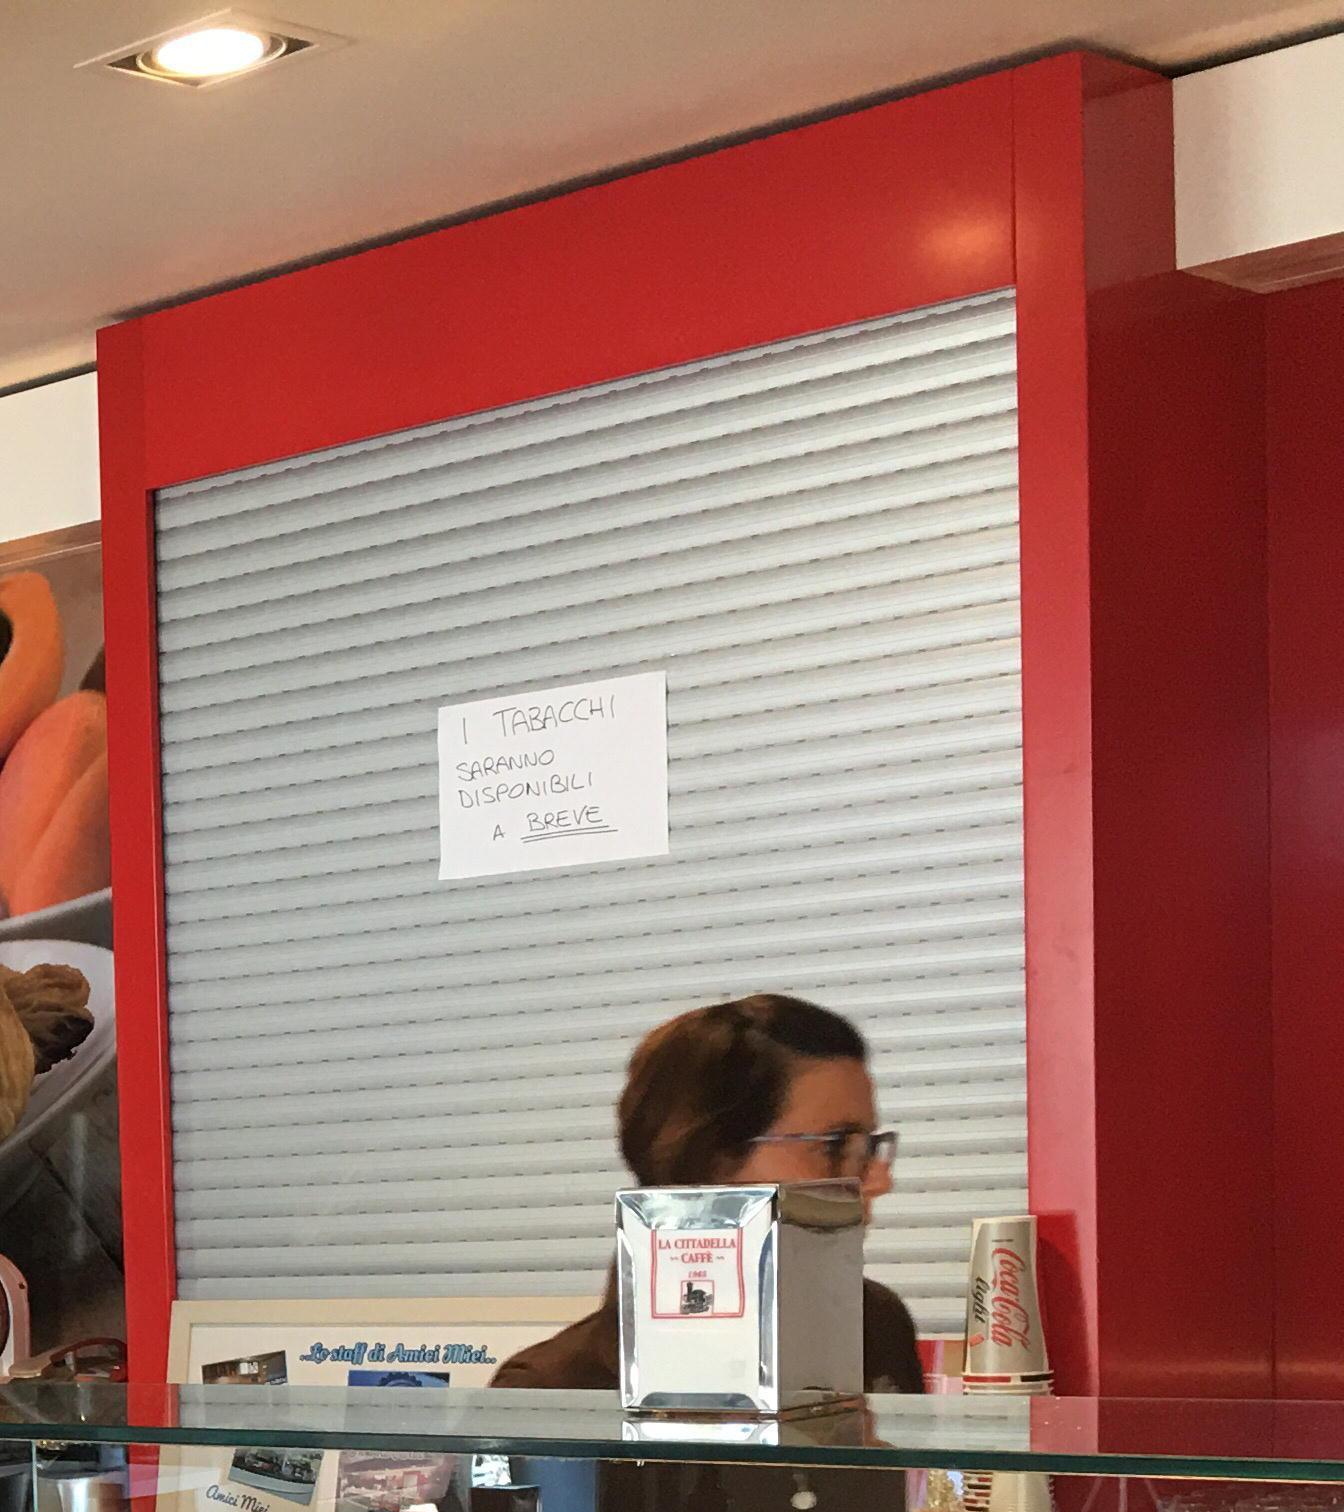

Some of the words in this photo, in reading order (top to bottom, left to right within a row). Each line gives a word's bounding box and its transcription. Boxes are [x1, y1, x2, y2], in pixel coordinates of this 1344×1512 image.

[462, 717, 468, 744] I
[493, 695, 616, 737] TABACCHI
[456, 750, 555, 782] SARANNO
[458, 772, 593, 808] DISPONIBILI
[492, 824, 506, 841] A
[527, 805, 604, 832] BREVE
[658, 1239, 671, 1250] LA
[674, 1238, 736, 1249] CITTADELLA
[681, 1250, 713, 1263] CAFFÈ
[330, 1342, 367, 1365] staff
[368, 1343, 385, 1363] di
[387, 1344, 439, 1363] Amici
[206, 1484, 238, 1506] Amici
